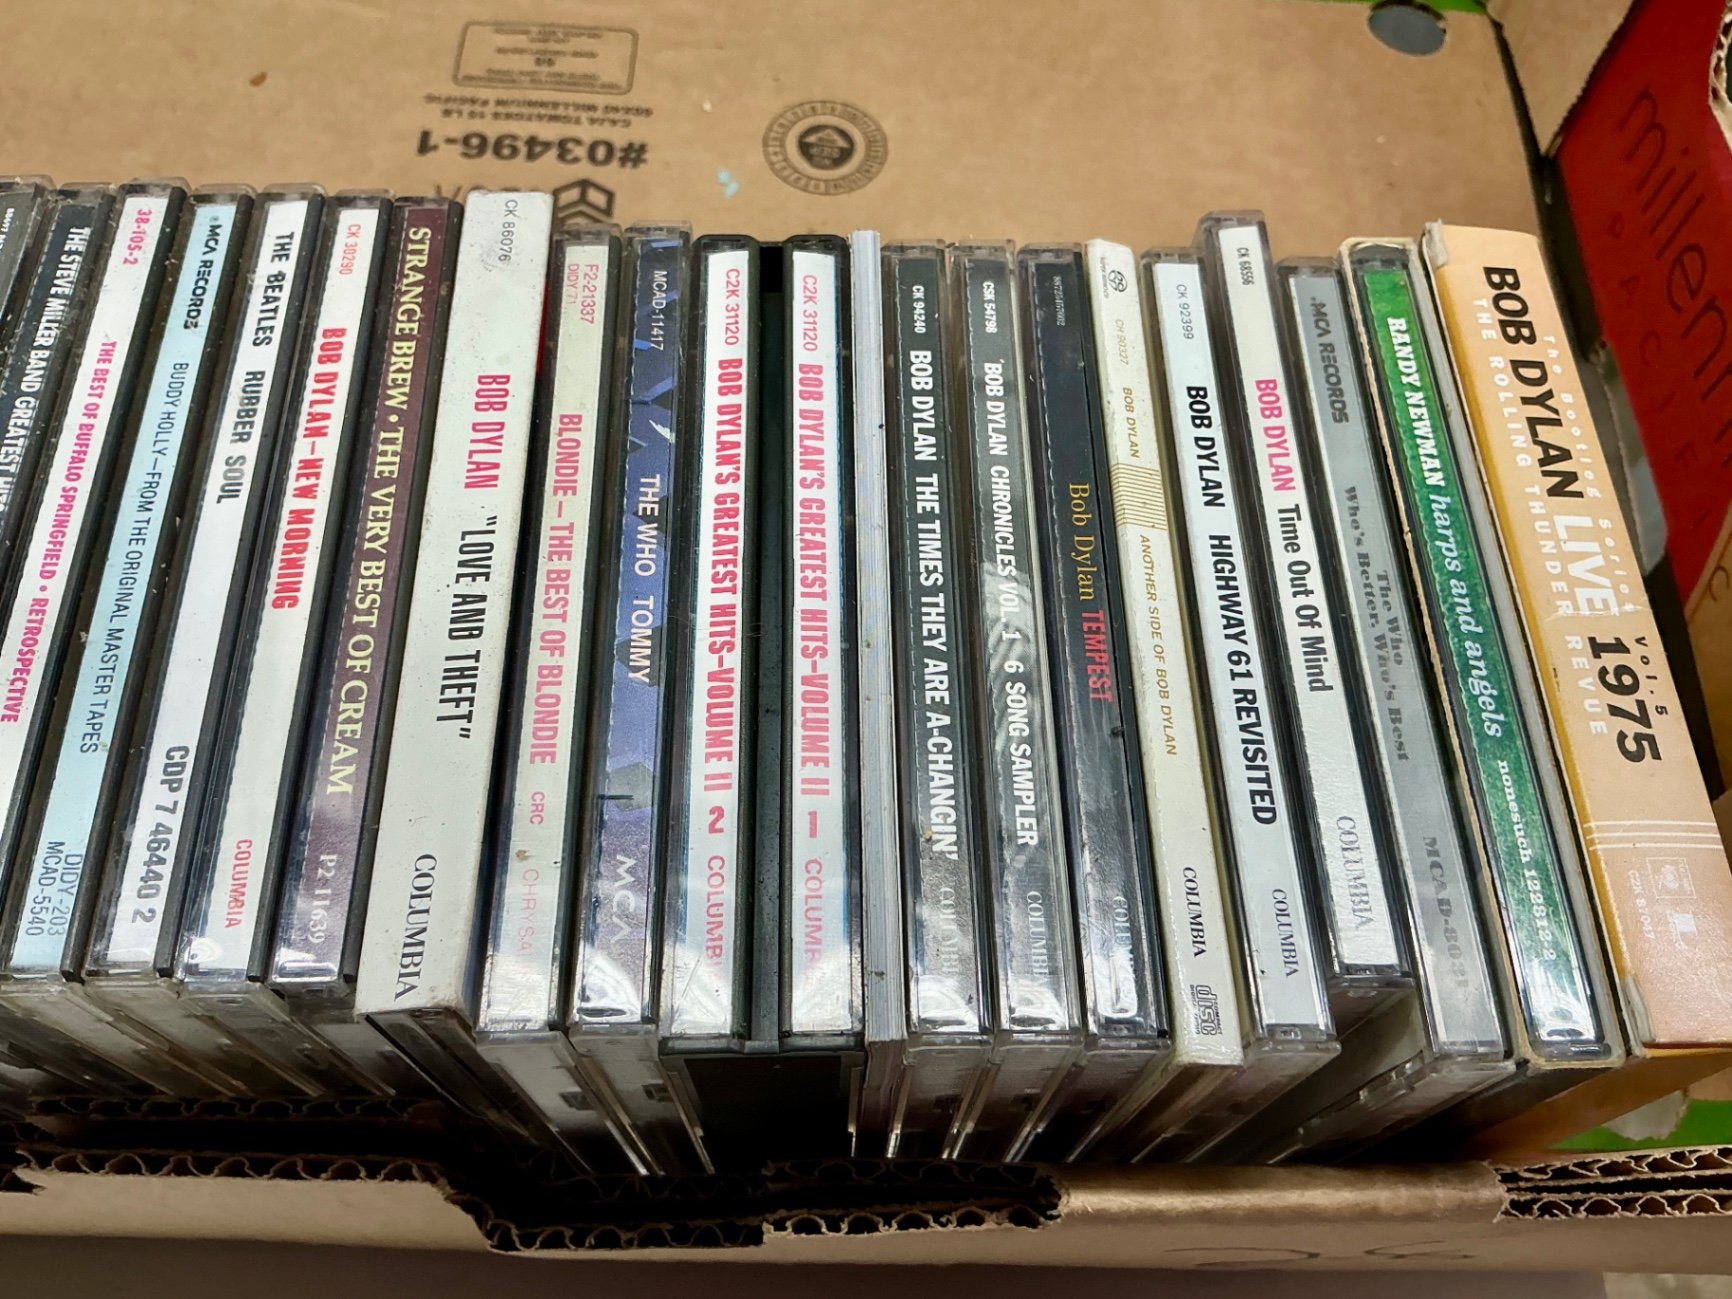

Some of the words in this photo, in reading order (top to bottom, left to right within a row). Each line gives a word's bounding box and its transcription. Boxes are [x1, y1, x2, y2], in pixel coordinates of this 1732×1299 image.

[415, 130, 649, 169] #03496-1
[347, 224, 361, 239] CK
[503, 200, 518, 217] CK
[64, 226, 92, 252] THE
[123, 209, 152, 265] 38-105-2
[201, 224, 224, 256] MCA
[271, 231, 295, 263] THE
[339, 240, 357, 275] 30290
[498, 222, 516, 262] 86076
[1236, 247, 1249, 259] CK
[50, 253, 83, 296] STEVE
[184, 260, 214, 330] RECORDS
[395, 227, 431, 336] STRANGE
[580, 264, 599, 324] F2-21337
[726, 268, 740, 299] C2K
[802, 274, 818, 305] C2K
[912, 285, 924, 299] CK
[983, 281, 995, 300] CSK
[1176, 284, 1188, 299] CK
[1241, 260, 1255, 286] 68556
[33, 297, 67, 347] MILLER
[252, 270, 286, 347] BEATLES
[649, 270, 667, 350] MCAD-11417
[724, 303, 740, 346] 31120
[802, 310, 818, 351] 31120
[913, 302, 926, 334] 94240
[983, 303, 997, 334] 54798
[1178, 303, 1194, 340] 92399
[1311, 301, 1331, 338] MCA
[1483, 266, 1537, 345] BOB
[20, 350, 52, 393] BAND
[96, 341, 117, 365] THE
[317, 328, 347, 365] BOB
[910, 350, 933, 391] BOB
[1387, 317, 1421, 387] RANDY
[87, 367, 110, 399] BEST
[166, 362, 190, 408] BUDDY
[385, 340, 416, 410] BREW
[474, 375, 511, 412] BOB
[718, 358, 743, 397] BOB
[798, 363, 824, 402] BOB
[984, 363, 1005, 397] BOB
[1123, 387, 1135, 413] BOB
[1255, 379, 1283, 420] BOB
[1318, 342, 1349, 424] RECORDS
[82, 404, 100, 419] OF
[230, 370, 266, 444] RUBBER
[912, 396, 937, 461] DYLAN
[986, 402, 1008, 456] DYLAN
[1186, 386, 1213, 429] BOB
[1508, 359, 1584, 498] DYLAN
[0, 396, 36, 474] GREATEST
[65, 423, 95, 483] BUFFALO
[374, 427, 404, 479] THE
[464, 422, 505, 489] DYLAN
[714, 403, 742, 485] DYLAN'S
[798, 409, 826, 490] DYLAN'S
[1128, 418, 1141, 459] DYLAN
[1262, 426, 1296, 492] DYLAN
[1404, 390, 1445, 486] NEWMAN
[216, 455, 247, 504] SOUL
[638, 474, 661, 517] THE
[915, 473, 940, 514] THE
[1193, 436, 1225, 508] DYLAN
[128, 516, 151, 547] THE
[364, 485, 396, 554] VERY
[990, 465, 1017, 577] CHRONICLES
[1069, 483, 1092, 526] Bob
[1277, 503, 1302, 554] Time
[1473, 298, 1497, 340] THE
[1488, 356, 1532, 467] ROLLING
[1524, 485, 1573, 616] THUNDER
[1564, 635, 1608, 735] REVUE
[1543, 335, 1563, 375] The
[1560, 392, 1601, 498] Bootleg
[1655, 705, 1669, 715] 5
[39, 486, 78, 580] SPRINGFIELD
[272, 508, 315, 609] MORNING
[455, 515, 498, 584] "LOVE
[634, 523, 659, 576] WHO
[710, 492, 740, 595] GREATEST
[799, 498, 828, 601] GREATEST
[917, 520, 944, 587] TIMES
[1429, 493, 1462, 572] harps
[110, 551, 143, 624] ORIGINAL
[1071, 535, 1097, 601] Dylan
[1139, 534, 1158, 602] ANOTHER
[1208, 534, 1249, 646] HIGHWAY
[1287, 560, 1314, 598] Out
[1553, 514, 1620, 616] LIVE
[352, 559, 386, 628] BEST
[448, 594, 488, 641] AND
[542, 569, 571, 623] BEST
[999, 582, 1020, 623] VOL.
[1294, 604, 1323, 630] Of
[1376, 569, 1392, 612] The
[1386, 615, 1404, 666] Who
[1451, 578, 1483, 634] and
[539, 630, 566, 657] OF
[627, 596, 654, 682] TOMMY
[920, 593, 948, 652] THEY
[1002, 631, 1022, 641] 1
[1149, 607, 1162, 640] SIDE
[1344, 486, 1364, 547] Who's
[1373, 632, 1397, 701] Who's
[1388, 707, 1410, 761] Best
[1, 597, 49, 723] RETROSPECTIVE
[93, 628, 125, 695] MASTER
[345, 634, 375, 674] OF
[1003, 660, 1025, 674] 6
[1081, 610, 1114, 702] TEMPEST
[1153, 643, 1166, 664] OF
[1227, 650, 1254, 681] 61
[1300, 636, 1334, 692] Mind
[437, 650, 481, 739] THEFT"
[923, 658, 950, 705] ARE
[1156, 669, 1169, 704] BOB
[1465, 640, 1505, 738] angels
[1587, 636, 1662, 763] 1975
[80, 700, 108, 754] TAPES
[529, 665, 564, 765] BLONDIE
[1005, 681, 1030, 737] SONG
[1161, 705, 1177, 755] DYLAN
[326, 679, 368, 795] CREAM
[1232, 688, 1277, 825] REVISITED
[160, 745, 190, 793] CDP
[926, 711, 959, 860] A-CHANGIN'
[1009, 742, 1039, 846] SAMPLER
[155, 800, 179, 815] 7
[529, 791, 545, 825] CRC
[708, 805, 725, 835] 2
[807, 810, 818, 838] 1
[1498, 760, 1533, 863] nonesuch
[136, 822, 173, 900] 46440
[225, 838, 253, 929] COLUMBIA
[1336, 815, 1375, 929] COLUMBIA
[25, 841, 66, 936] MCAD-5540
[610, 855, 638, 943] MCA
[1182, 866, 1207, 958] COLUMBIA
[131, 908, 157, 924] 2
[394, 853, 437, 1002] COLUMBIA
[1271, 888, 1300, 978] COLUMBIA
[1195, 984, 1218, 1036] disc
